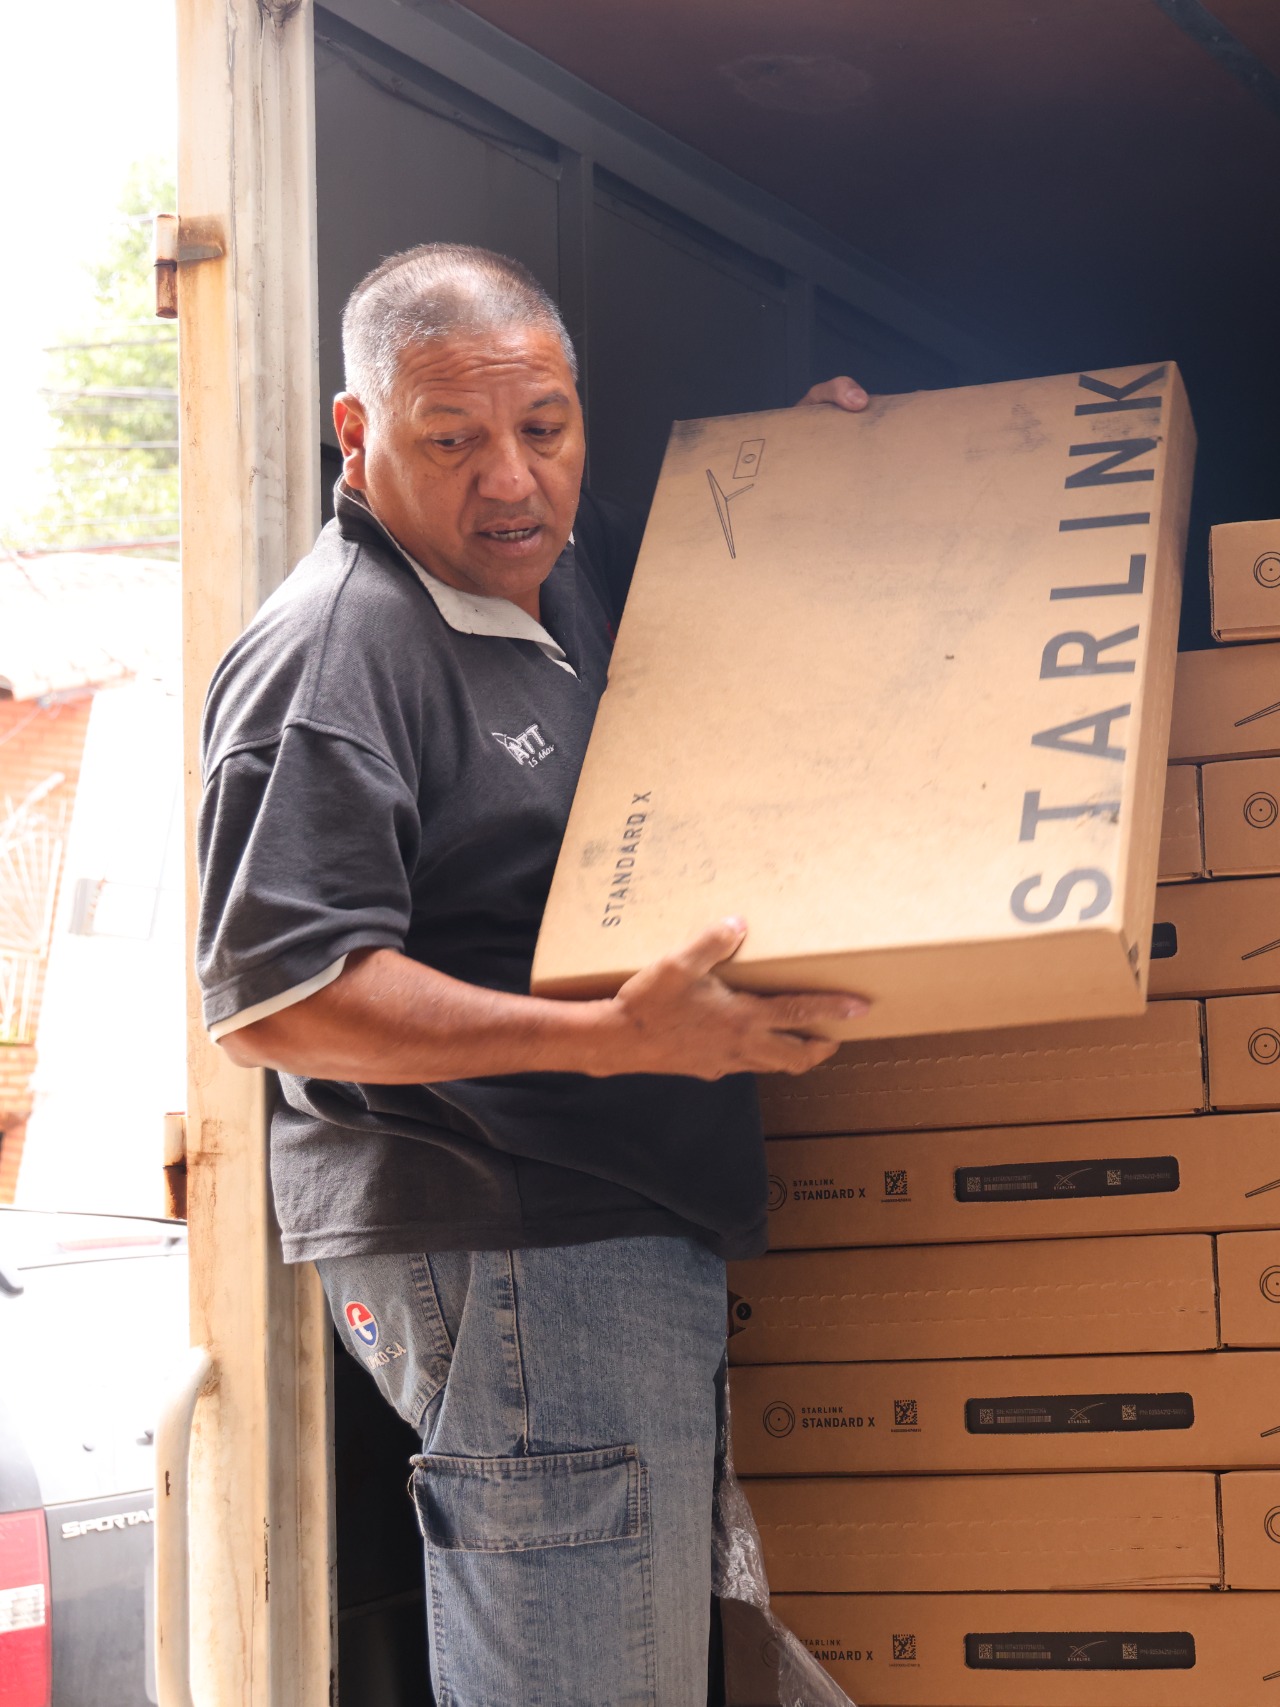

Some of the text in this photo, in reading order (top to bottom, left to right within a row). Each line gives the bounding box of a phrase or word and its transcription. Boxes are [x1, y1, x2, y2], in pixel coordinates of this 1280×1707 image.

[1010, 365, 1170, 925] STARLINK
[528, 756, 538, 768] 15
[602, 790, 652, 927] STANDARD X
[793, 1178, 834, 1188] STARLINK
[793, 1187, 866, 1201] STANDARD X
[801, 1406, 843, 1414] STARLINK
[802, 1416, 876, 1429] STANDARD X
[809, 1650, 874, 1661] ANDARD X
